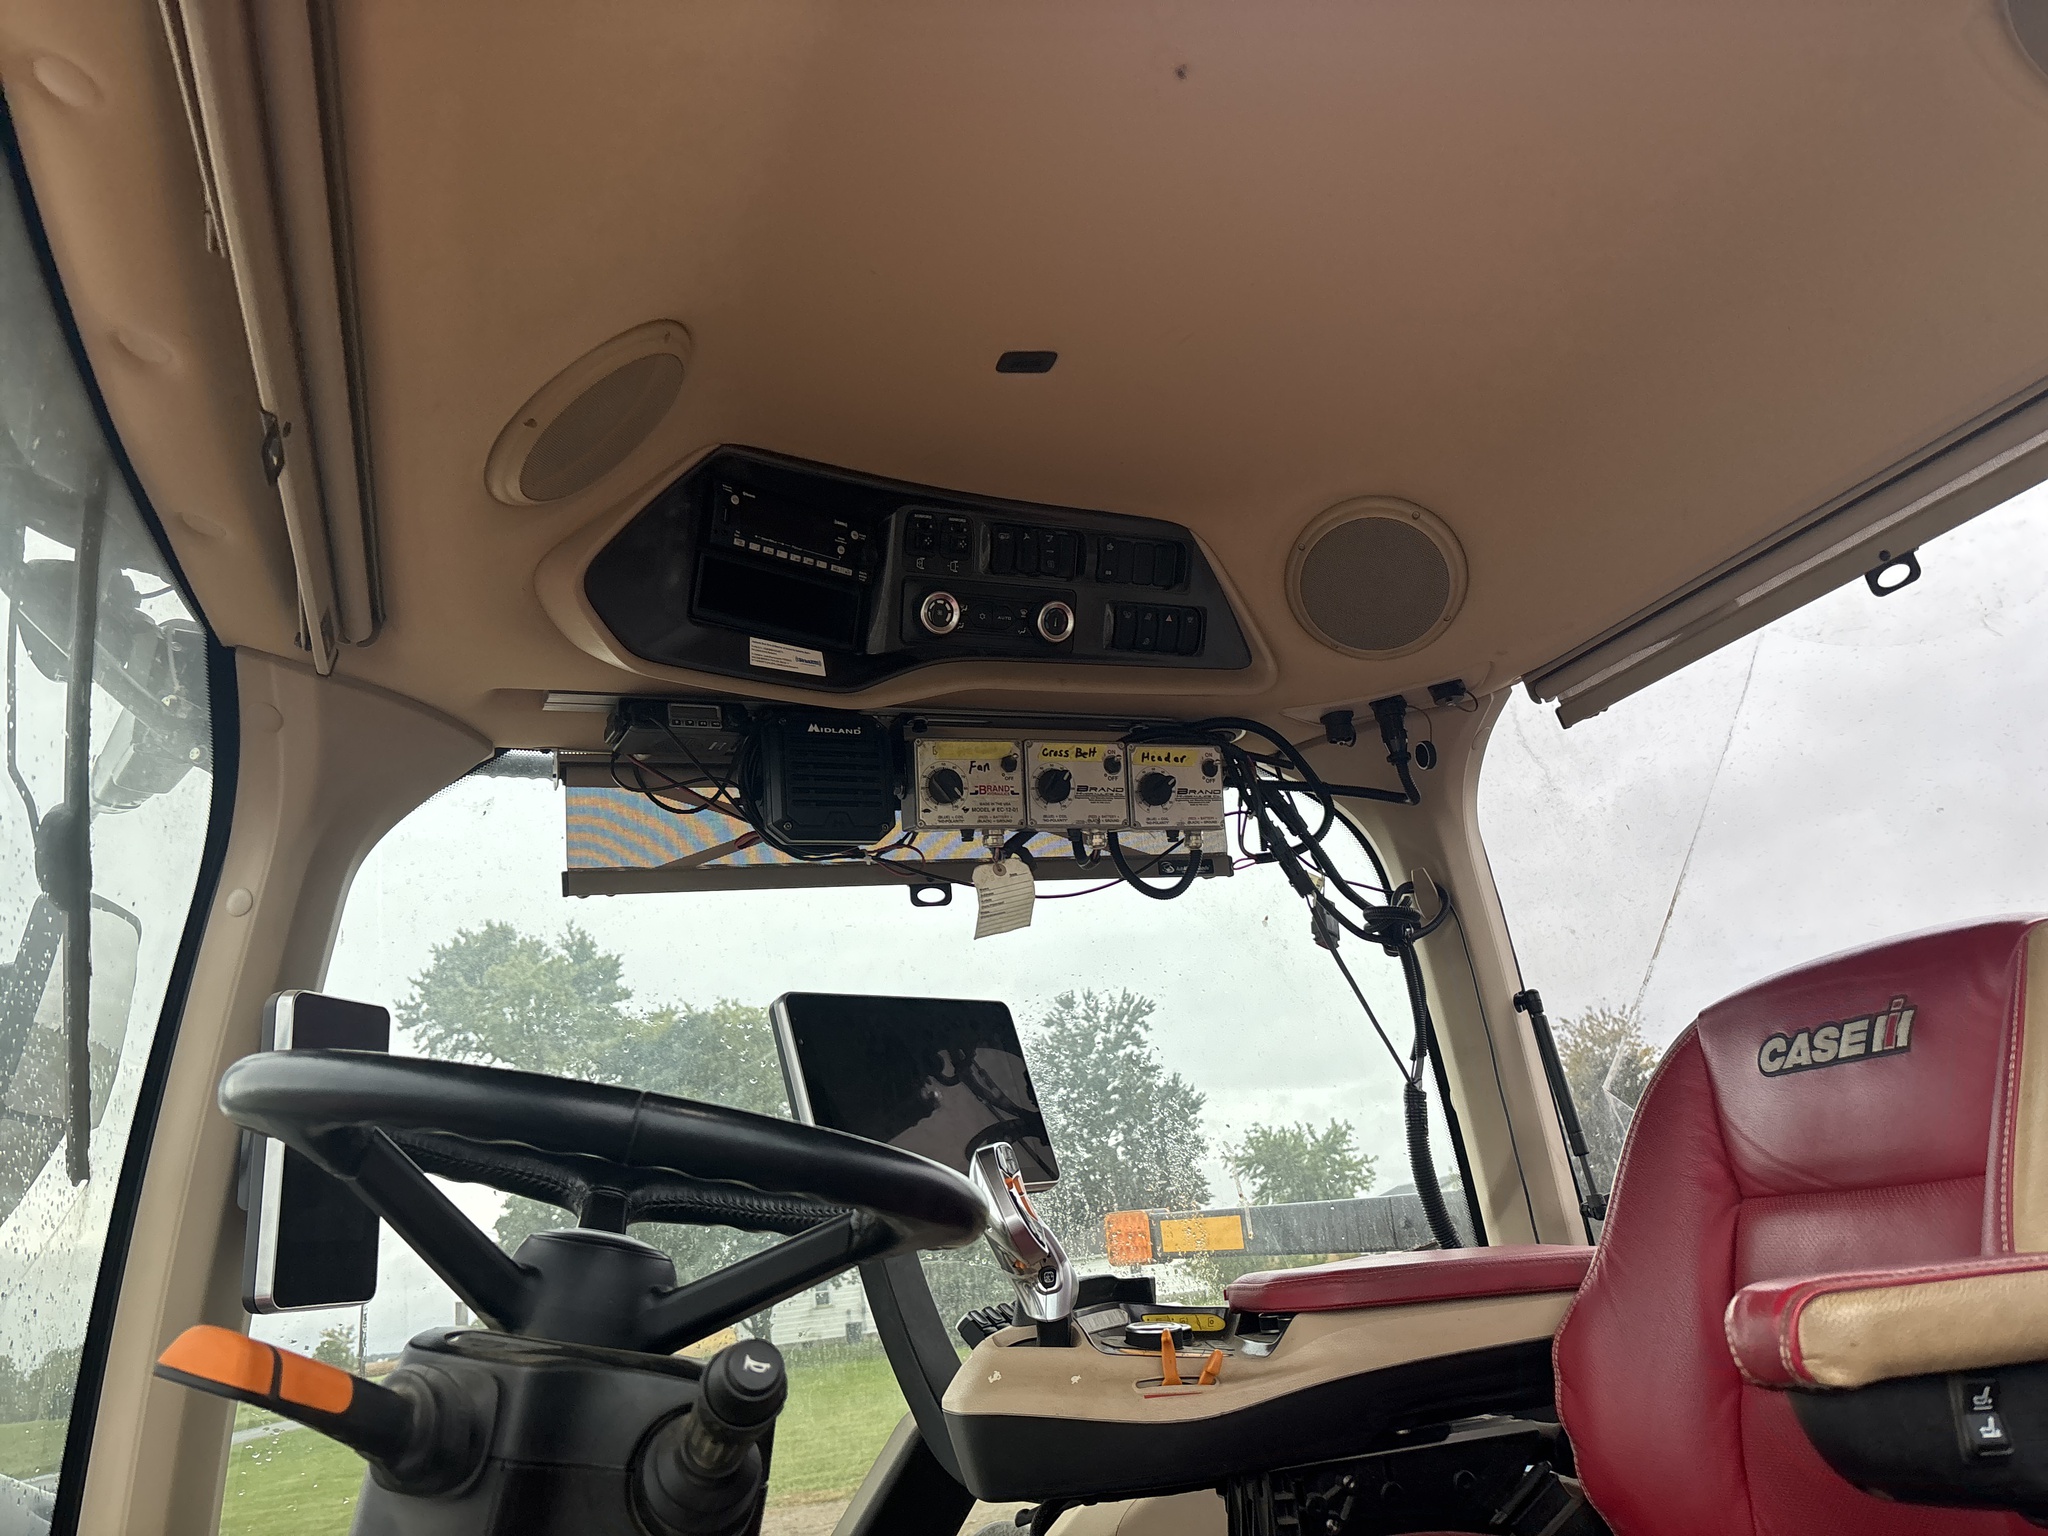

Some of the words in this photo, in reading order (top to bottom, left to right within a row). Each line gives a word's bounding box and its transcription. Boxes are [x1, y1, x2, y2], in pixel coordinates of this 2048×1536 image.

[808, 723, 861, 734] MIDLAND
[1042, 748, 1070, 758] Cross
[969, 760, 990, 775] Fan
[979, 785, 1010, 795] BRAND
[1077, 785, 1124, 793] BRAND
[1758, 1017, 1869, 1074] CASE
